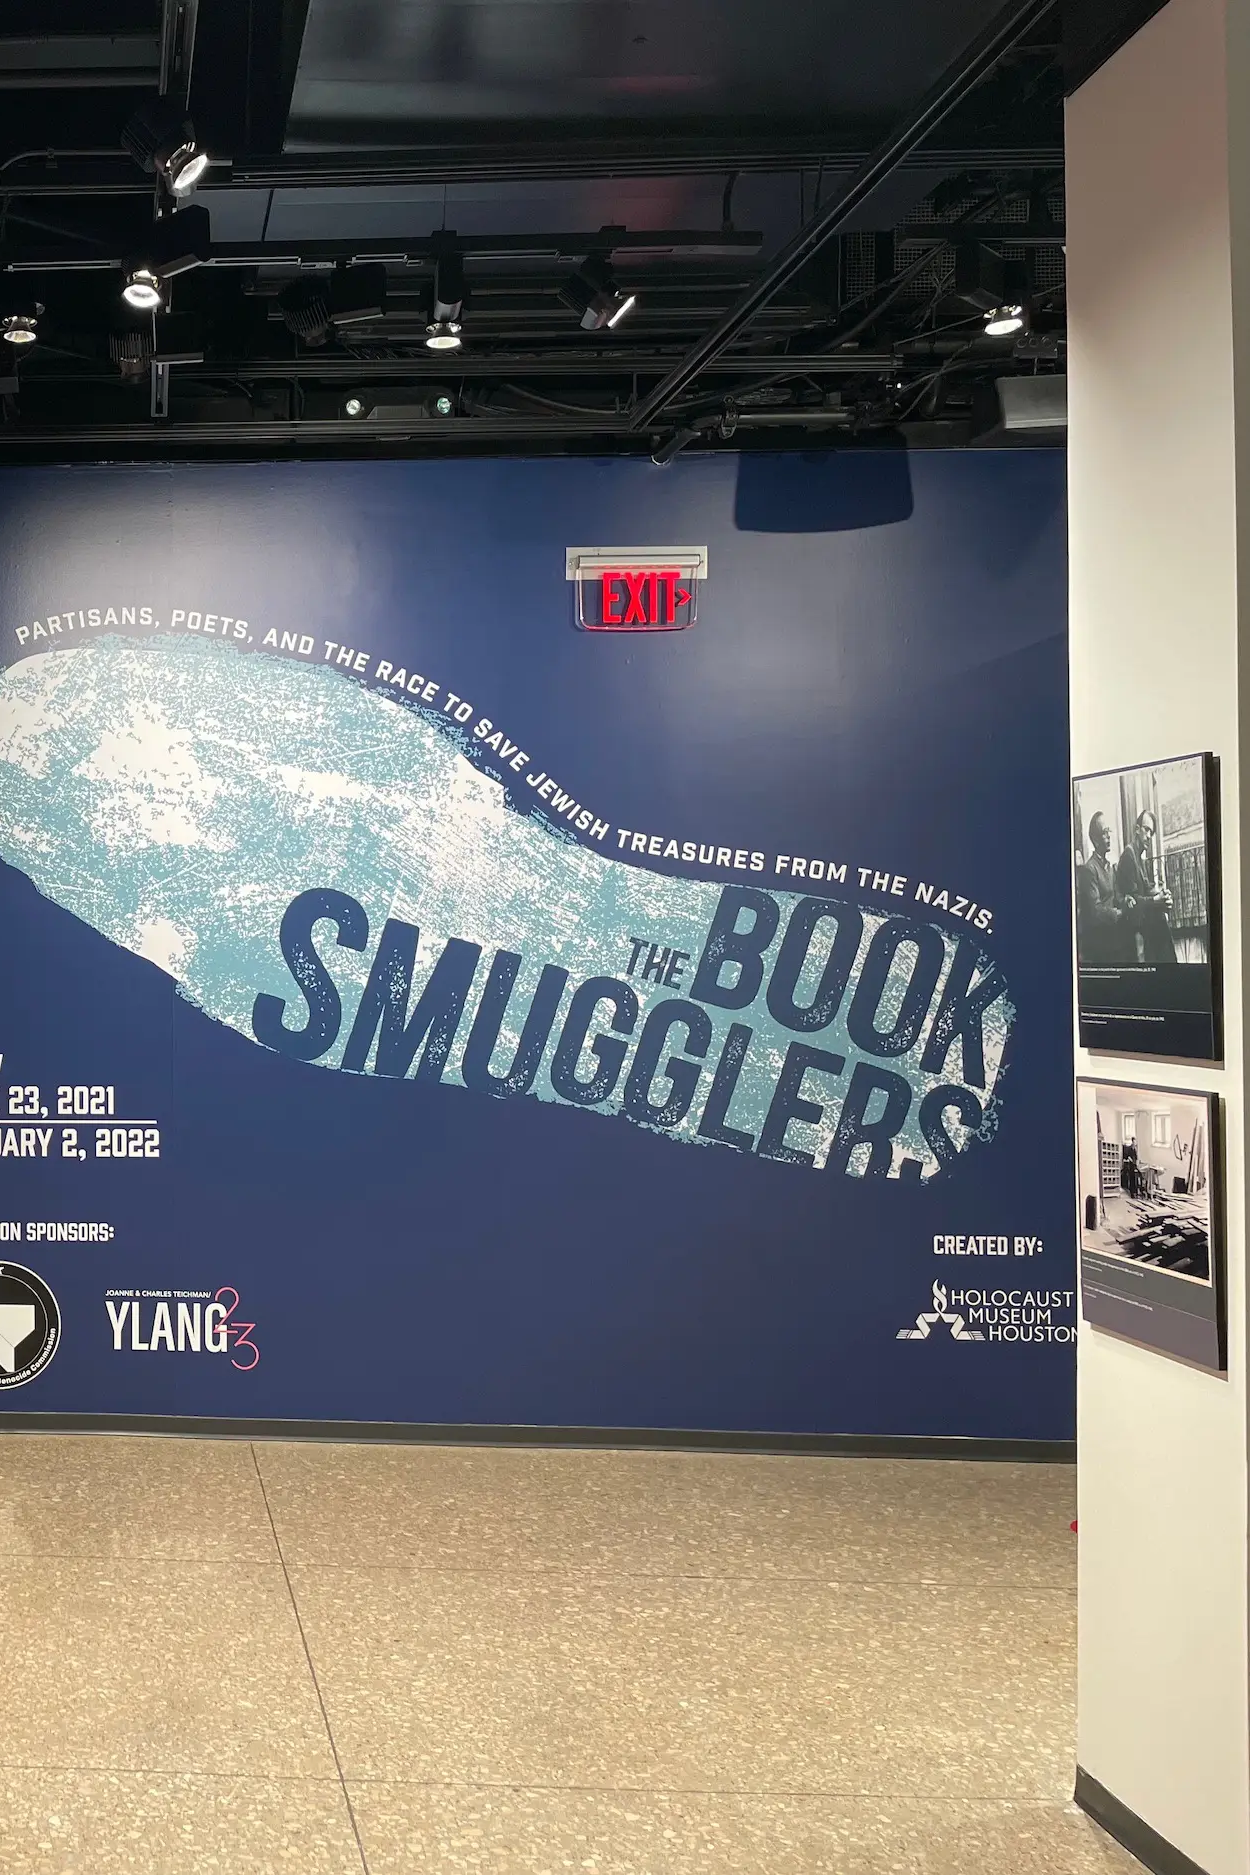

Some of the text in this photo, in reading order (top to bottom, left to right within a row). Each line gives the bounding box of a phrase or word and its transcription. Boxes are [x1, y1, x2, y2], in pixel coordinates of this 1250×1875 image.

[602, 572, 681, 623] EXIT
[14, 607, 994, 934] PARTISANS, POETS, AND THE RACE TO SAVE JEWISH TREASURES FROM THE NAZIS.
[626, 884, 1006, 1091] THE BOOK
[252, 887, 984, 1179] SMUGGLERS
[8, 1085, 49, 1118] 23,
[57, 1086, 115, 1115] 2021
[62, 1128, 87, 1161] 2,
[96, 1129, 160, 1158] 2022
[26, 1222, 114, 1242] SPONSORS:
[933, 1235, 1043, 1257] CREATED BY:
[105, 1289, 134, 1297] JOANNE
[135, 1289, 140, 1297] &
[142, 1290, 172, 1298] CHARLES
[951, 1289, 1074, 1308] HOLOCAUST
[105, 1301, 228, 1353] YLANG
[969, 1307, 1051, 1324] MUSEUM
[30, 1328, 56, 1372] Commission
